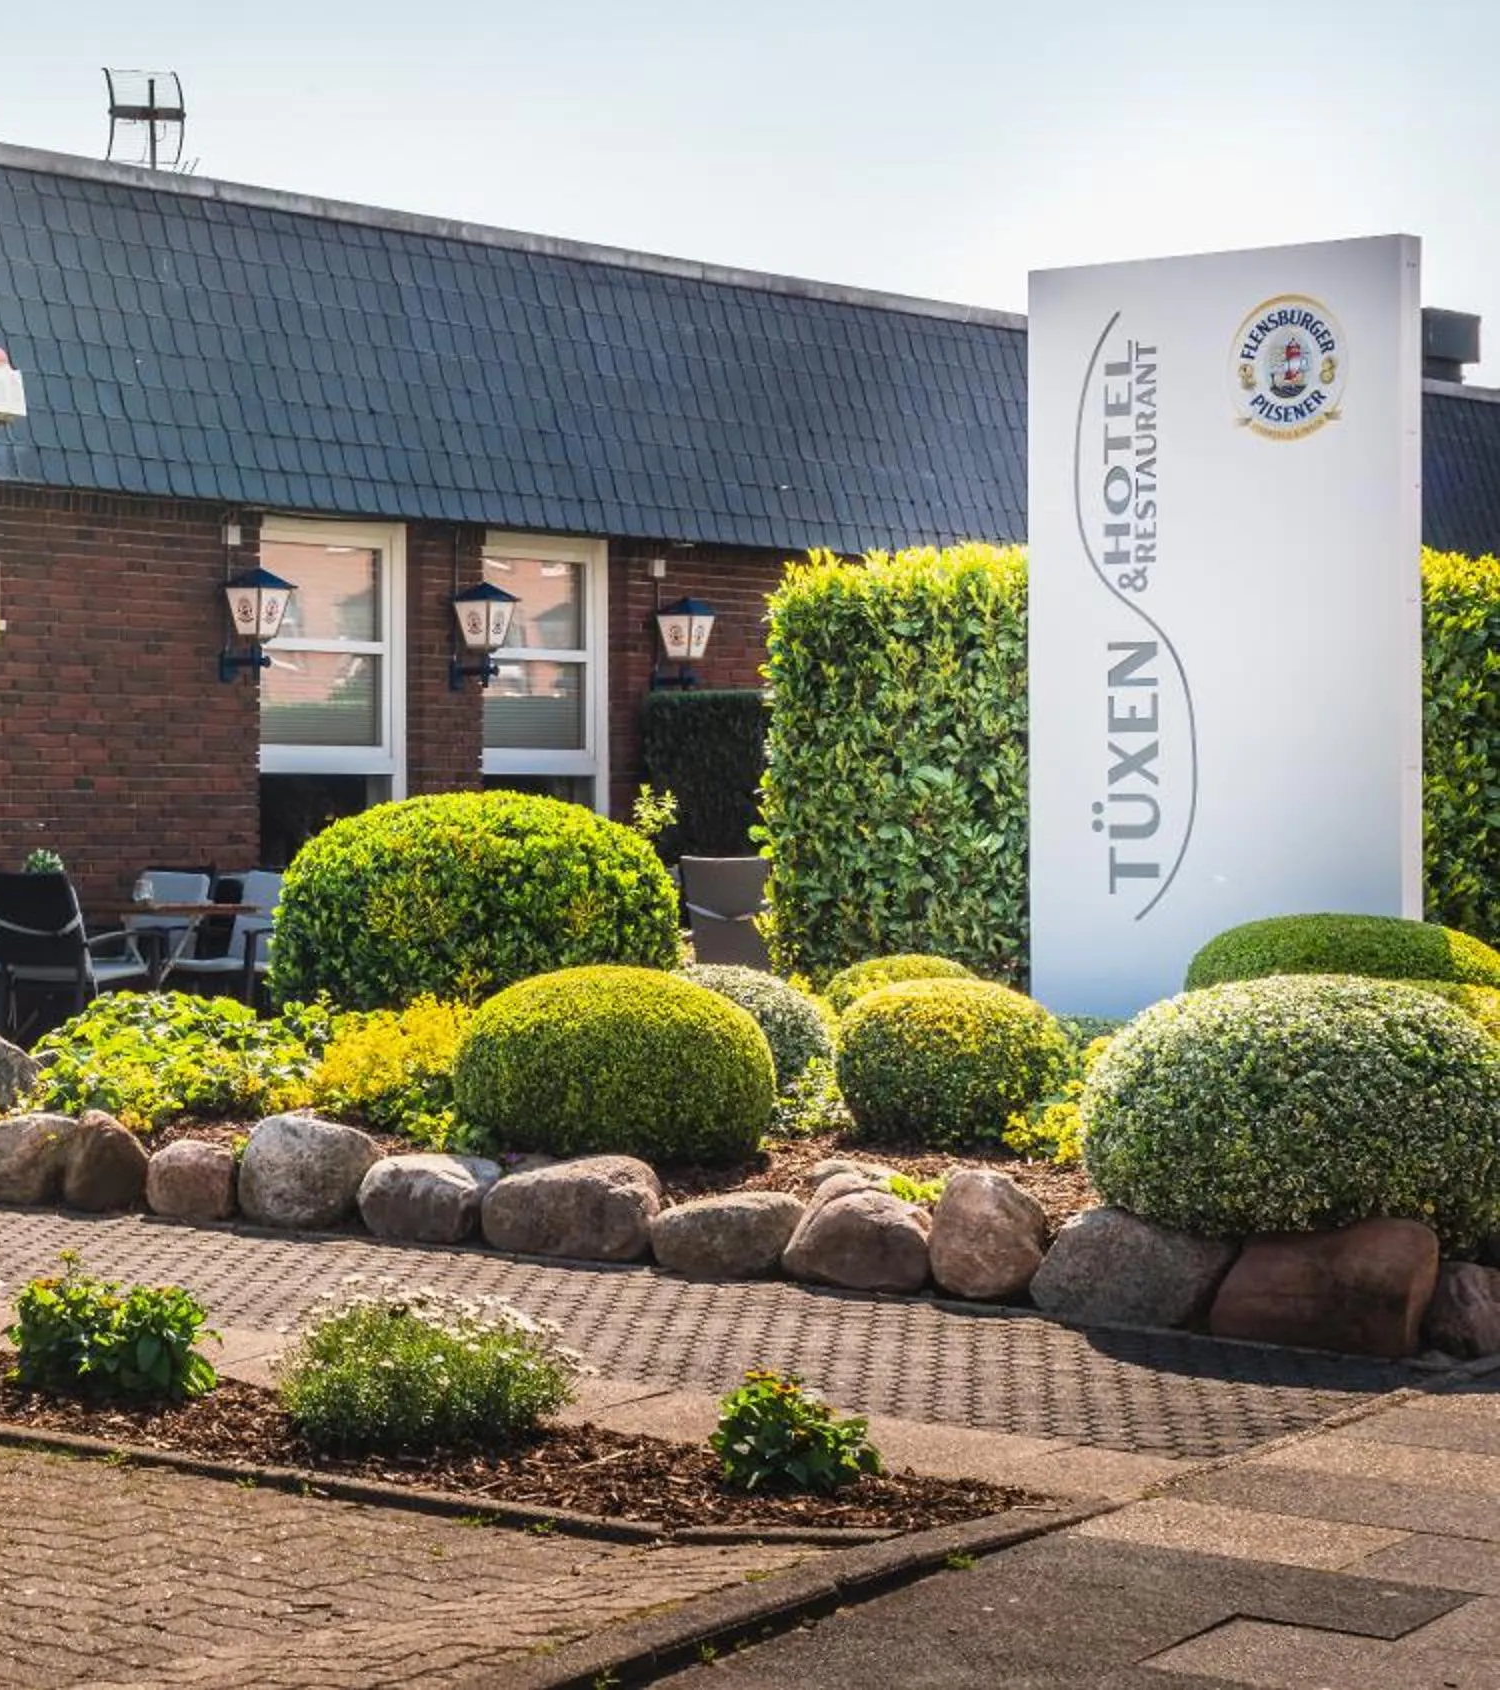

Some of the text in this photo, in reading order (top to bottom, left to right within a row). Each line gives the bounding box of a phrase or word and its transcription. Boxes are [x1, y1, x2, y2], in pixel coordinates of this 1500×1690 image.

[1240, 308, 1335, 360] FLENSBURGER
[1250, 389, 1328, 422] PILSENER
[1103, 339, 1132, 565] HOTEL
[1134, 341, 1157, 563] RESTAURANT
[1091, 641, 1161, 895] TÜXEN
